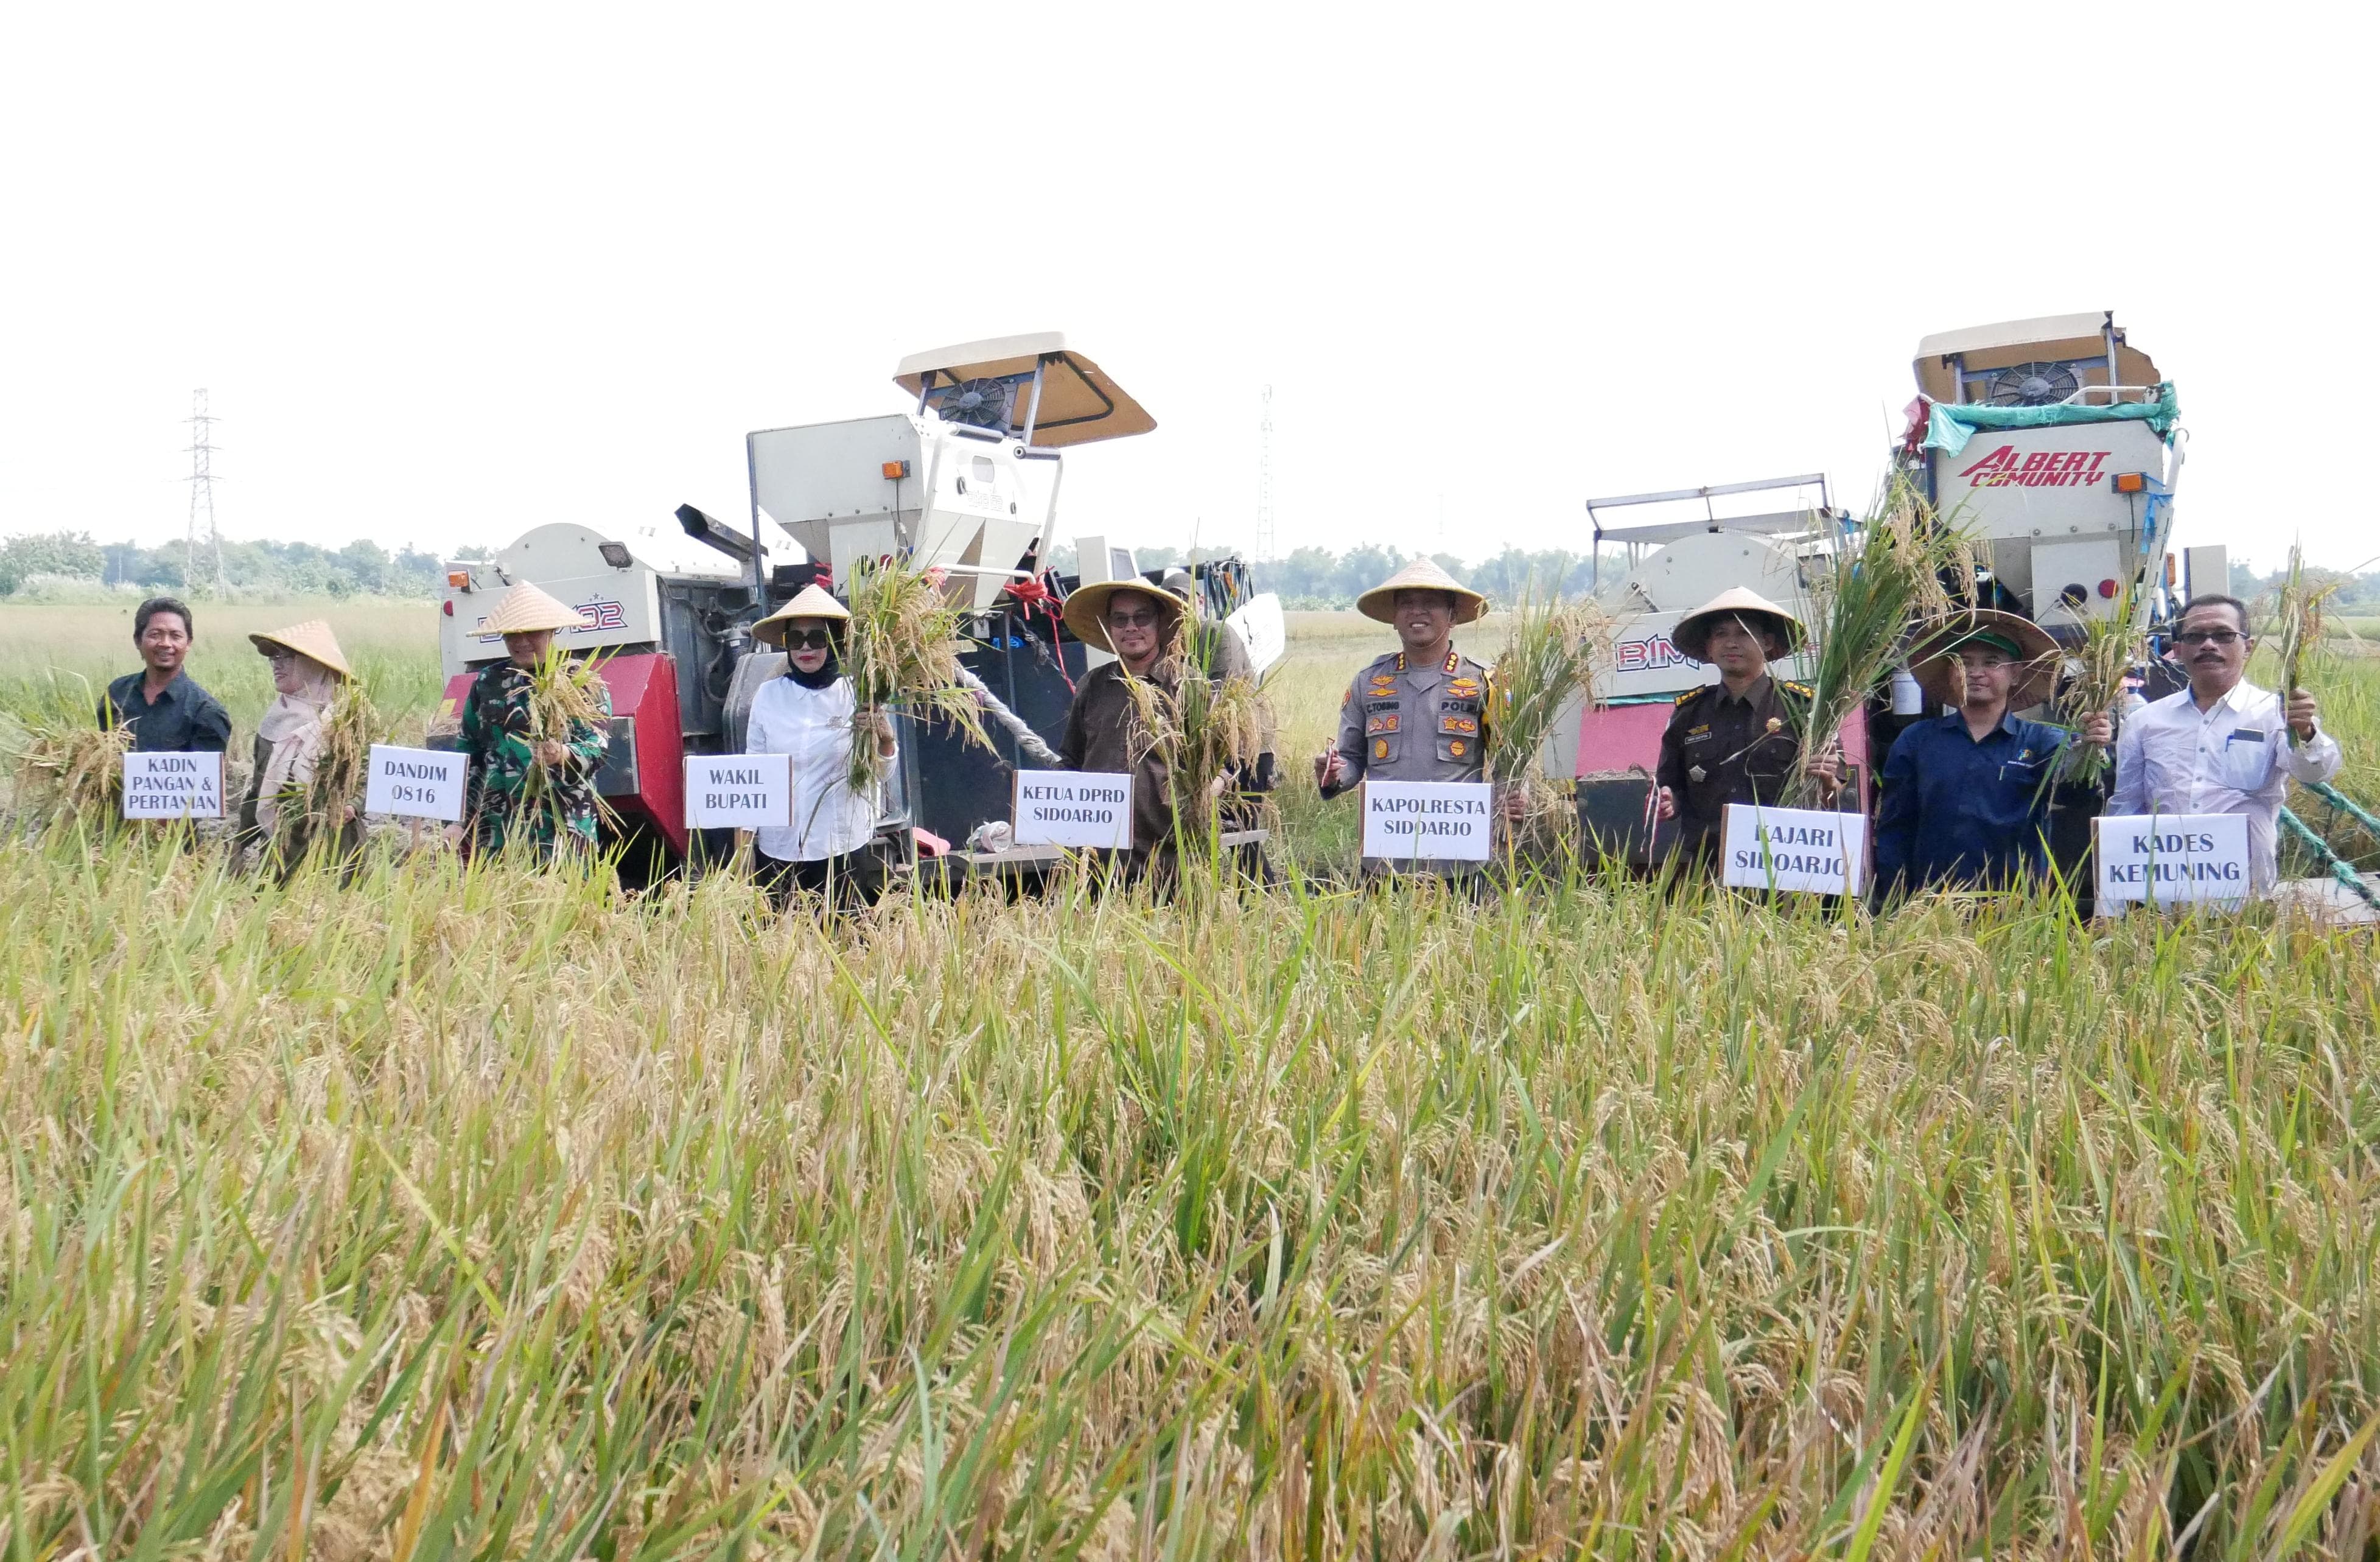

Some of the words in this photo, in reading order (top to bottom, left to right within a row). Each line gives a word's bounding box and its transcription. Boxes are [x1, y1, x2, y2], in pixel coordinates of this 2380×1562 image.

[1958, 445, 2112, 477] ALBERT
[1969, 471, 2105, 488] COMUNITY
[148, 758, 197, 772] KADIN
[385, 761, 447, 782] DANDIM
[133, 776, 195, 791] PANGAN
[201, 776, 212, 791] &
[709, 769, 764, 785] WAKIL
[129, 795, 216, 809] PERTANIAN
[391, 785, 435, 804] 0816
[705, 793, 766, 809] BUPATI
[1023, 785, 1073, 801] KETUA
[1079, 788, 1125, 803] DPRD
[1034, 807, 1113, 823] SIDOARJO
[1372, 798, 1486, 815] KAPOLRESTA
[1384, 820, 1472, 836] SIDOARJO
[2132, 833, 2214, 853] KADES
[2110, 862, 2240, 883] KEMUNING
